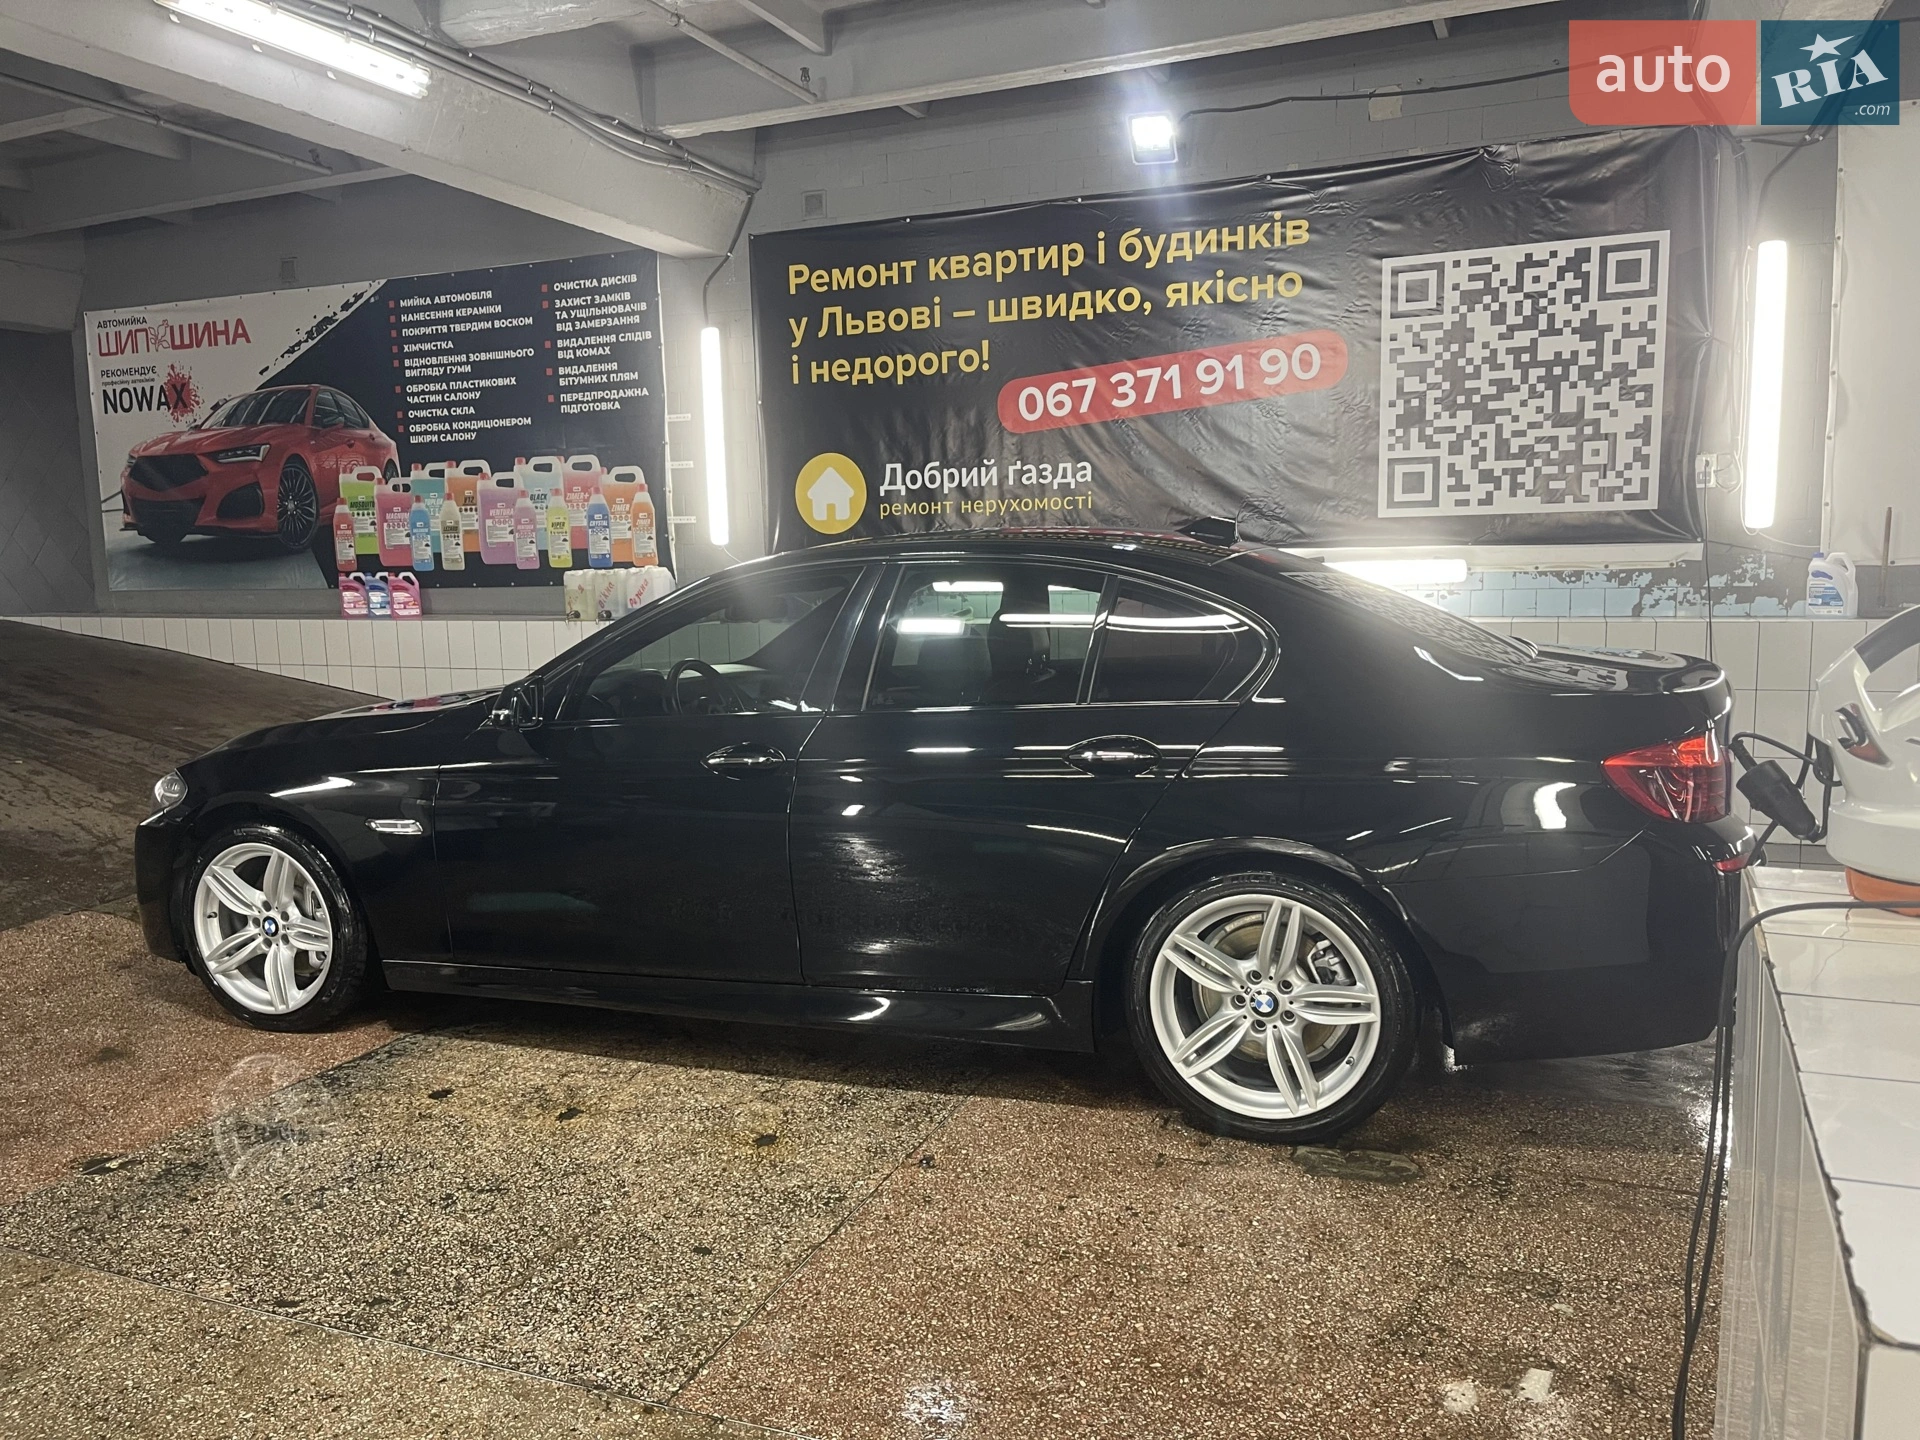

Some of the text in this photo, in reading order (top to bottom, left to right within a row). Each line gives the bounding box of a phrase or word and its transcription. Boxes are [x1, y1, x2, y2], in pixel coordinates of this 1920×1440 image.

[788, 260, 917, 294] Ремонт
[928, 241, 1084, 283] квартир
[1119, 212, 1310, 268] будинків
[553, 273, 638, 292] ОЧИСТКА ДИСКІВ
[400, 290, 493, 308] МИЙКА АВТОМОБІЛЯ
[554, 291, 631, 309] ЗАХИСТ ЗАМКІВ
[401, 304, 502, 322] НАНЕСЕННЯ КЕРАМІКИ
[555, 302, 648, 320] ТА УЩІЛЬНЮВАЧІВ
[789, 316, 808, 347] у
[818, 296, 941, 338] Львові
[988, 286, 1152, 323] швидко,
[1166, 270, 1303, 307] якісно
[96, 315, 148, 330] АВТОМИЙКА
[402, 316, 533, 337] ПОКРИТТЯ ТВЕРДИМ ВОСКОМ
[556, 315, 640, 332] ВІД ЗАМЕРЗАННЯ
[403, 340, 454, 353] ХІМЧИСТКА
[556, 330, 653, 348] ВИДАЛЕННЯ СЛІДІВ
[404, 347, 535, 368] ВІДНОВЛЕННЯ ЗОВНІШНЬОГО
[557, 345, 612, 360] ВІД КОМАХ
[558, 362, 618, 375] ВИДАЛЕННЯ
[811, 339, 990, 385] недорого!
[100, 365, 157, 379] РЕКОМЕНДУЄ
[405, 364, 472, 378] ВИГЛЯДУ ГУМИ
[559, 371, 639, 386] БІТУМНИХ ПЛЯМ
[406, 376, 517, 393] ОБРОБКА ПЛАСТИКОВИХ
[1018, 343, 1321, 422] 067 371 91 90
[102, 382, 188, 415] NOWAX
[406, 391, 482, 404] ЧАСТИН САЛОНУ
[560, 387, 650, 403] ПЕРЕДПРОДАЖНА
[408, 406, 476, 419] ОЧИСТКА СКЛА
[560, 401, 621, 414] ПІДГОТОВКА
[409, 416, 532, 433] ОБРОБКА КОНДИЦІОНЕРОМ
[410, 431, 477, 444] ШКІРИ САЛОНУ
[879, 458, 1092, 497] Добрий ґазда
[879, 491, 1093, 519] ремонт нерухомості
